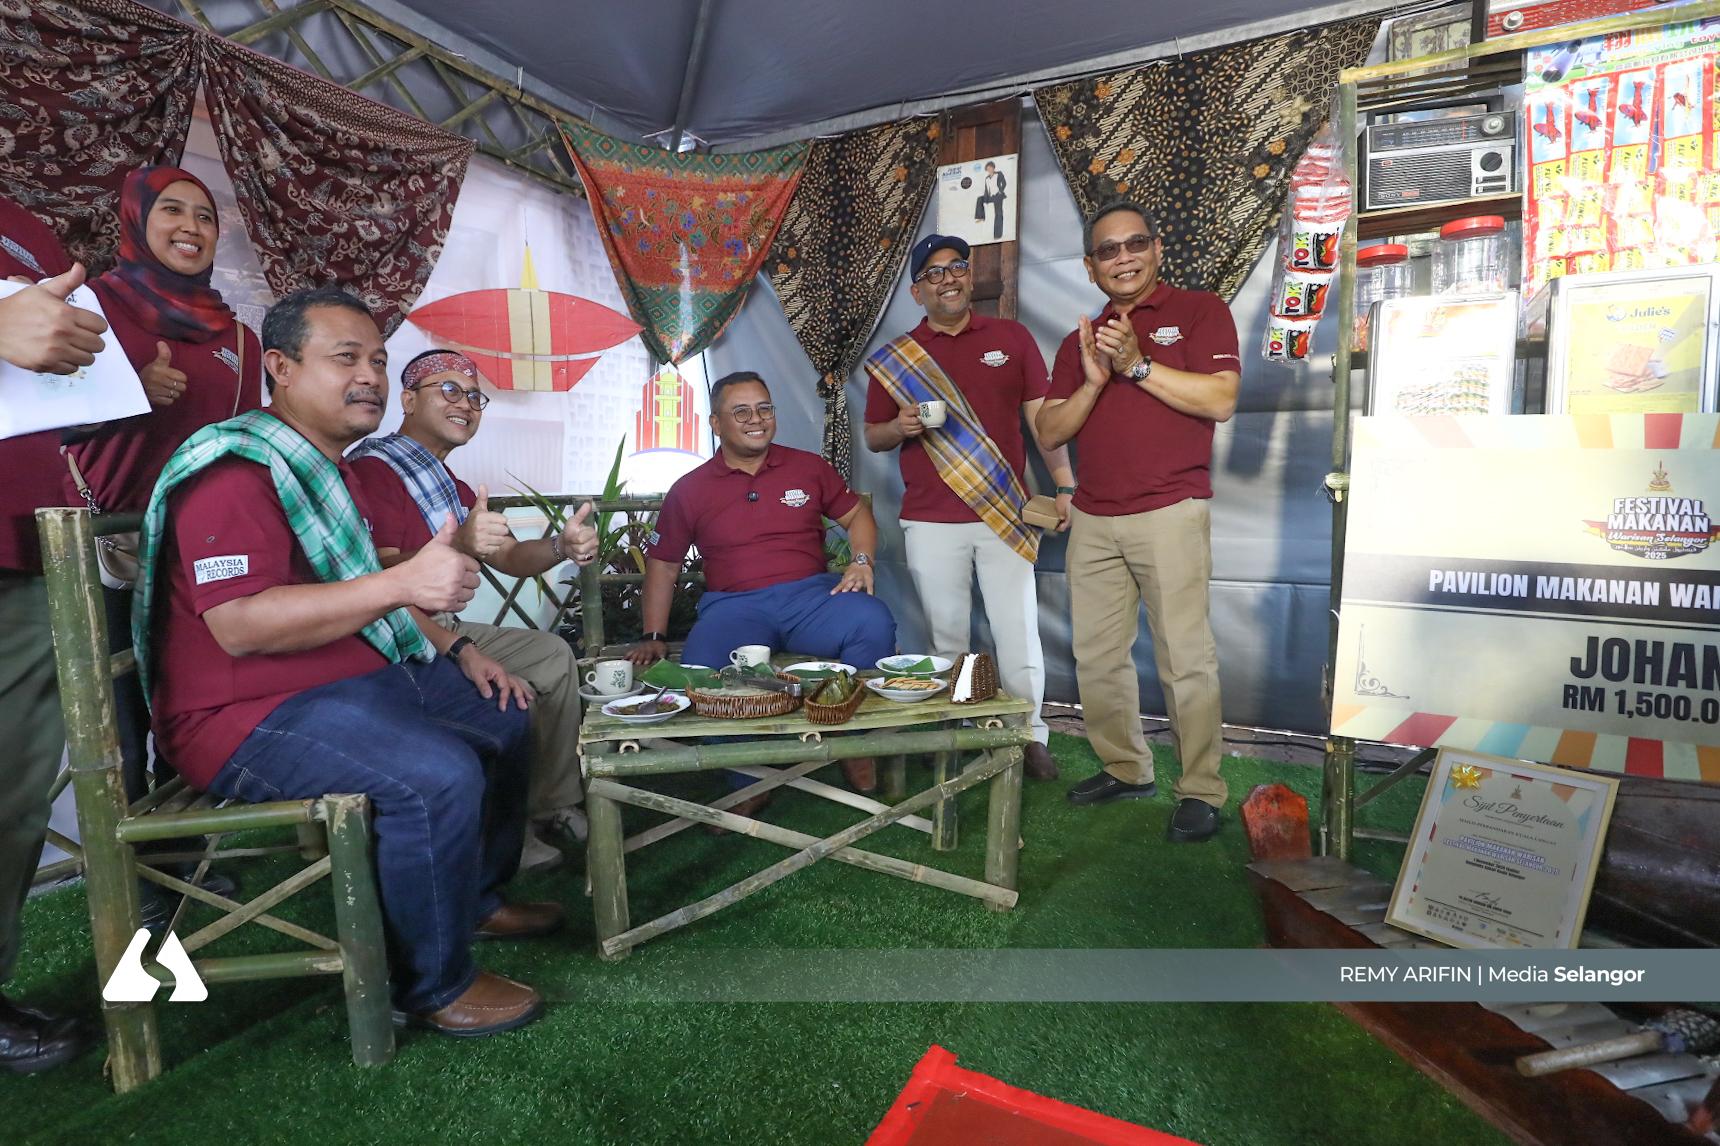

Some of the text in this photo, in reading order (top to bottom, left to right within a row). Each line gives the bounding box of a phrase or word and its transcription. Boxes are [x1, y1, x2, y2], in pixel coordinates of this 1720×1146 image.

[1629, 306, 1671, 318] Julie's
[1614, 497, 1705, 516] FESTIVAL
[1608, 514, 1709, 532] MAKANAN
[1608, 532, 1708, 548] Warisan Selangor
[1644, 551, 1667, 560] 2025
[196, 559, 244, 571] MALAYSIA
[206, 566, 245, 580] RECORDS
[1429, 569, 1528, 598] PAVILION
[1536, 575, 1660, 606] MAKANAN
[1563, 684, 1605, 713] RM
[1463, 795, 1496, 812] Sijil
